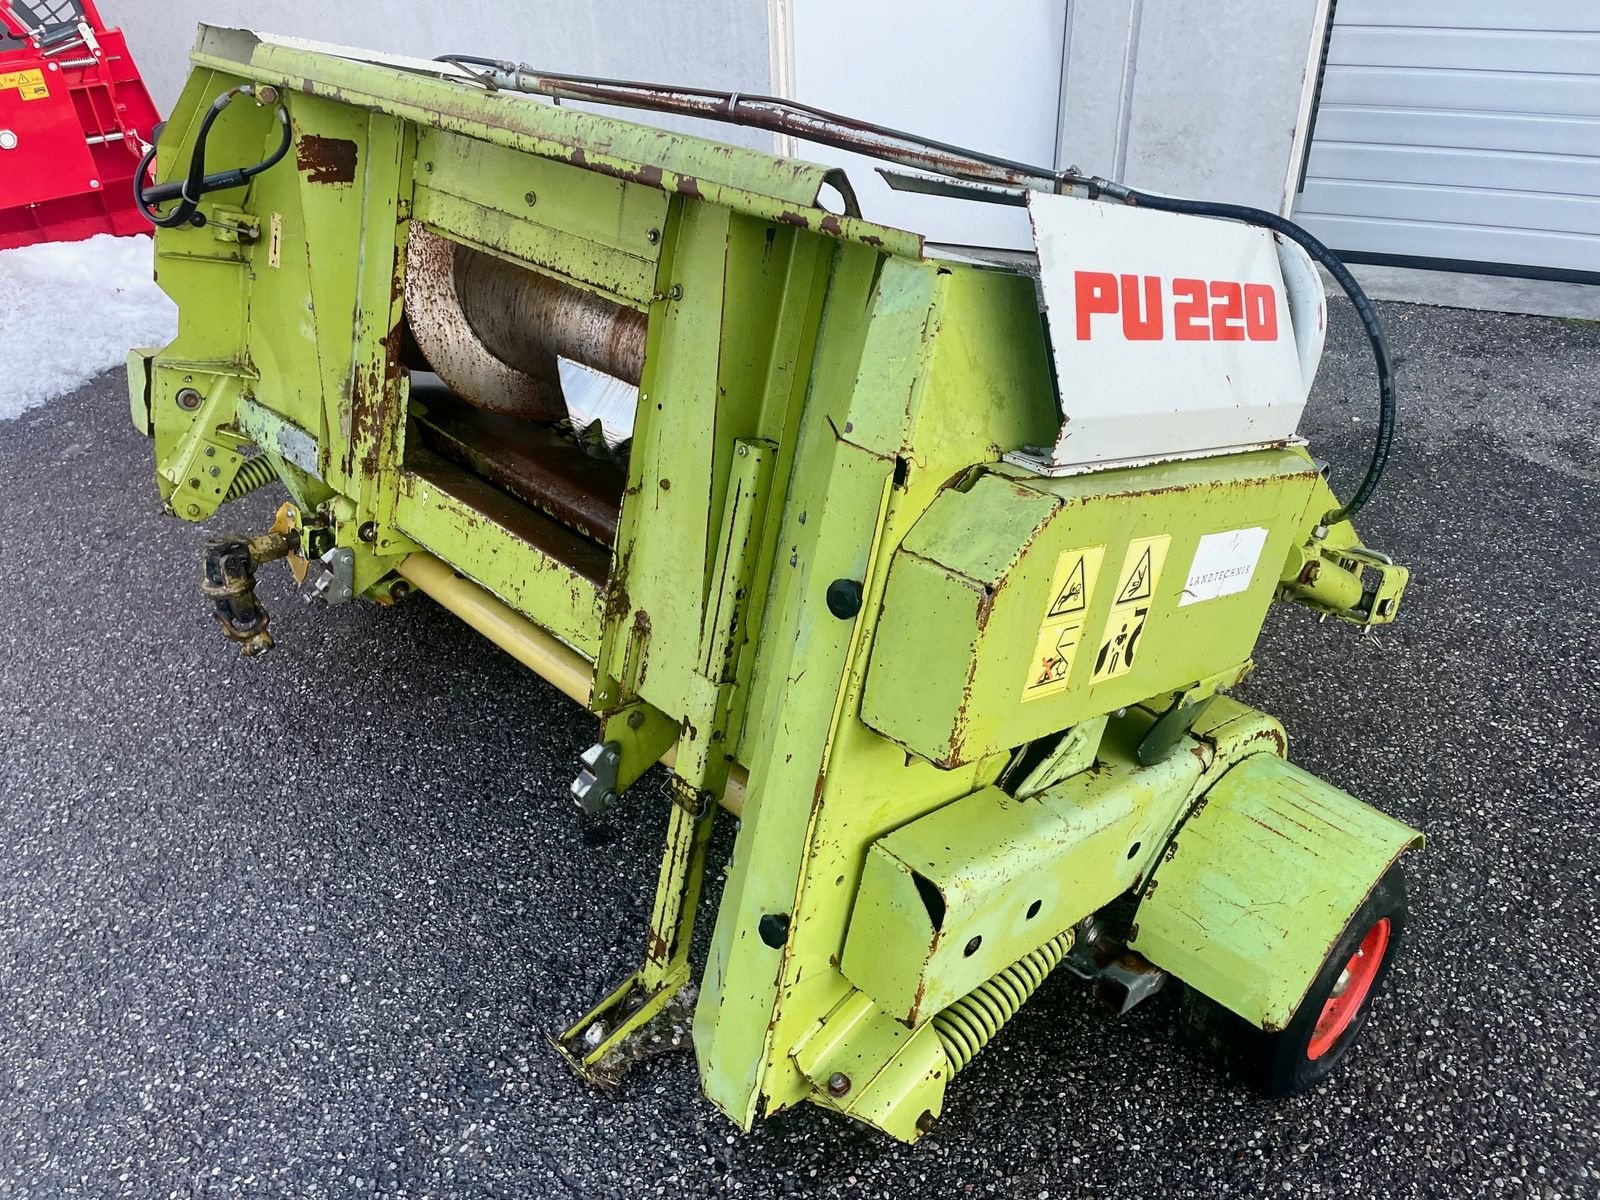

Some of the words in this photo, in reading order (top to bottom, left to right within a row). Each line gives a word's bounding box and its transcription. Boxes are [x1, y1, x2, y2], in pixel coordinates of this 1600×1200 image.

[1074, 270, 1164, 341] PU
[1172, 277, 1278, 341] 220
[1188, 564, 1252, 587] LANDTECHNIK
